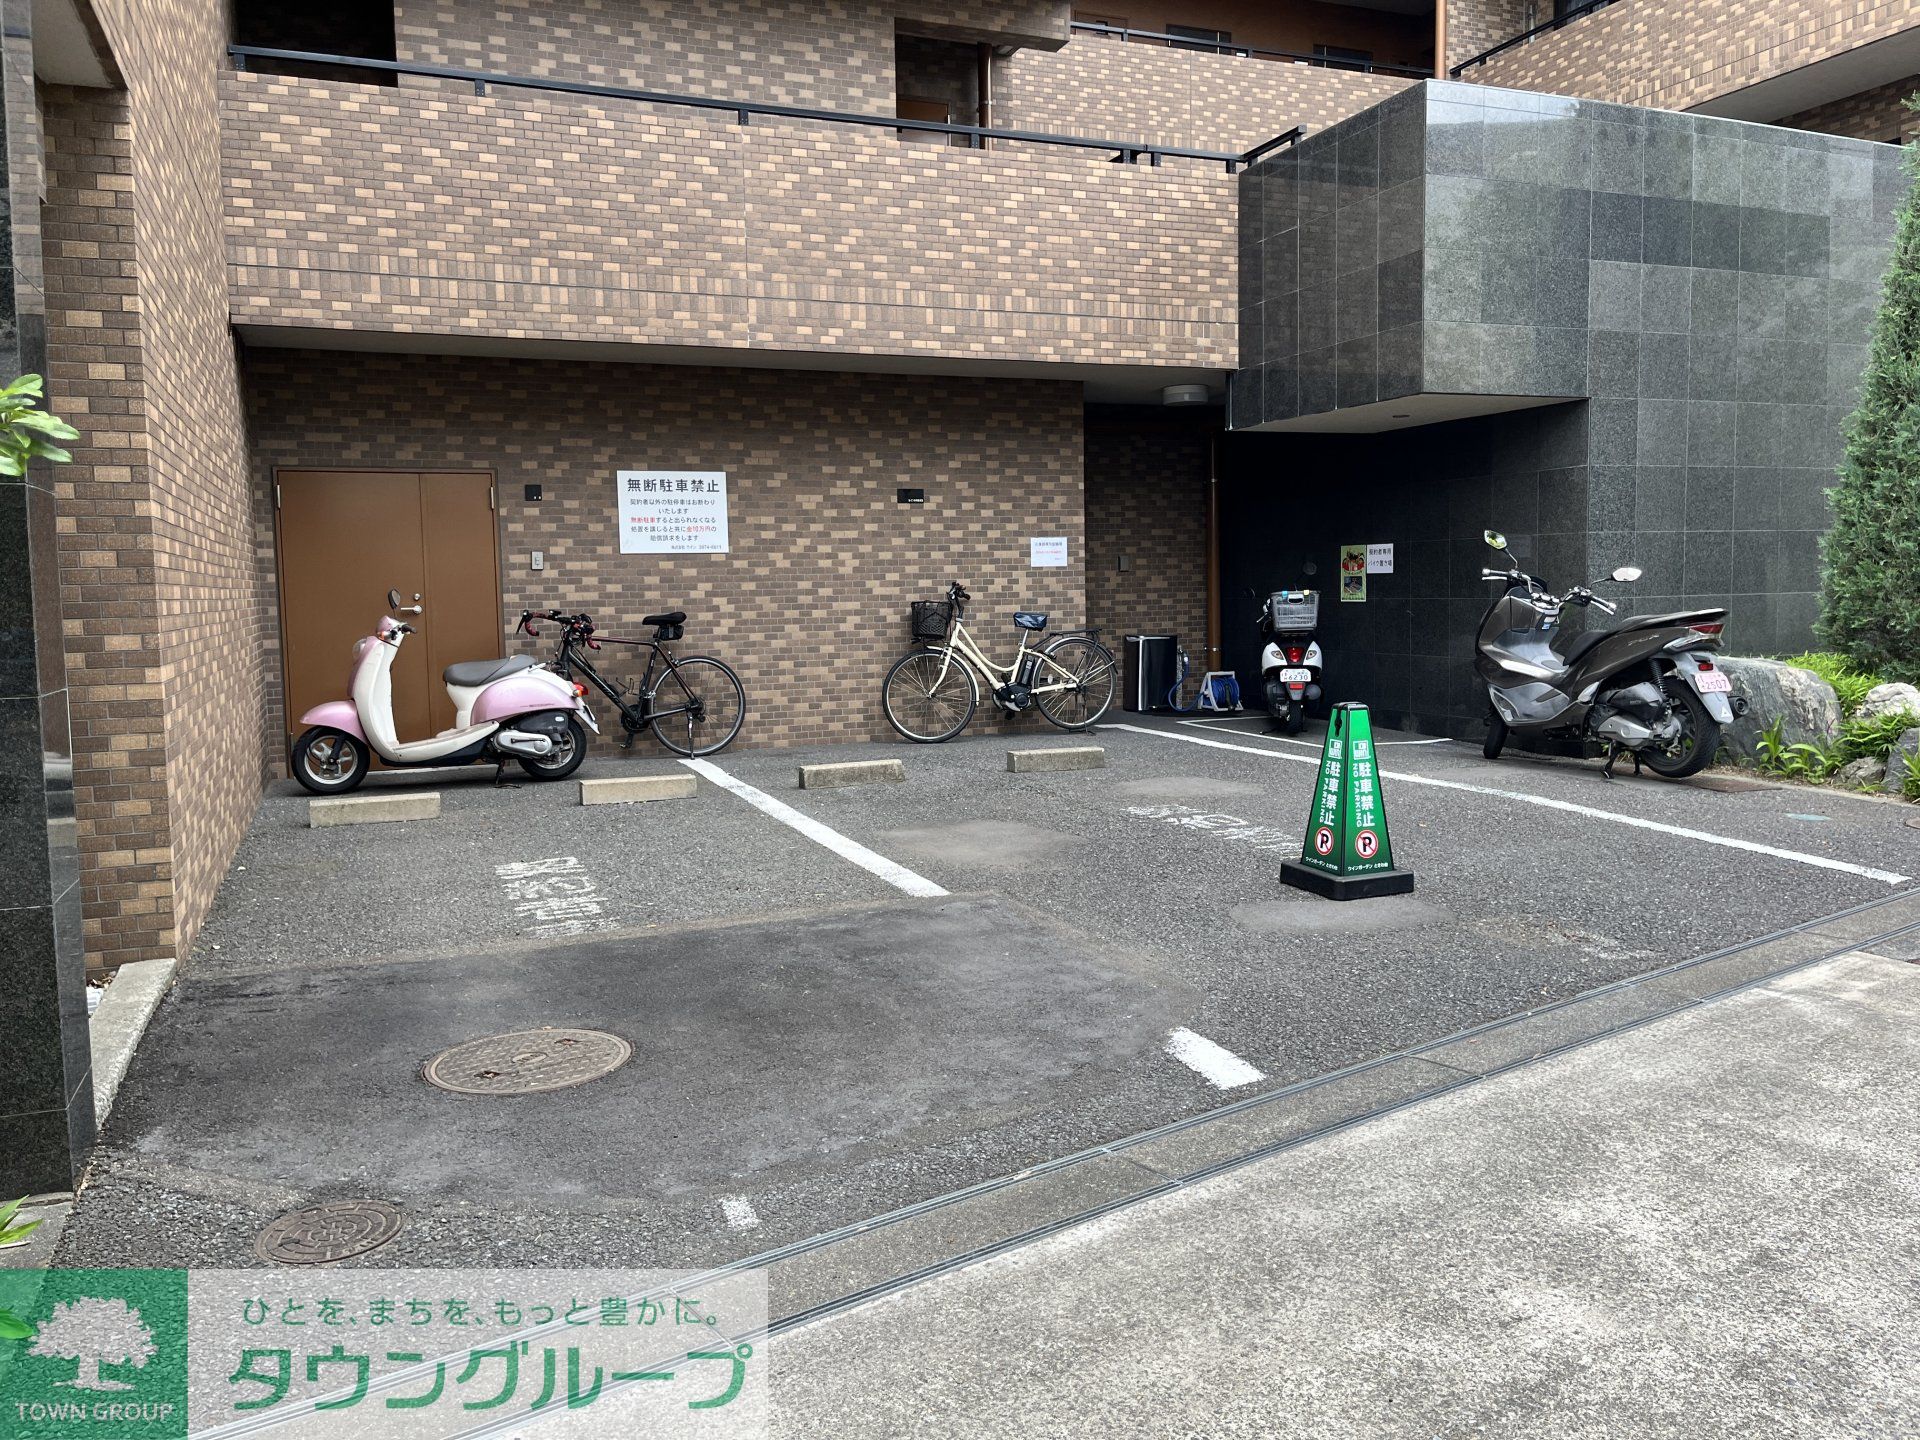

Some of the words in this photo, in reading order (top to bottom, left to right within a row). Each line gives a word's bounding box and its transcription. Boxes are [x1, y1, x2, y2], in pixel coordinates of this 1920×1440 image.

[627, 478, 720, 493] 無断駐車禁止
[630, 498, 715, 506] 契約者以外の駐停車はお断わり
[1325, 760, 1332, 775] NO
[1352, 763, 1359, 778] NO
[1319, 777, 1329, 823] PARKING
[1324, 761, 1341, 827] 駐車禁止
[1354, 781, 1363, 828] PARKING
[1358, 761, 1376, 828] 駐車禁止
